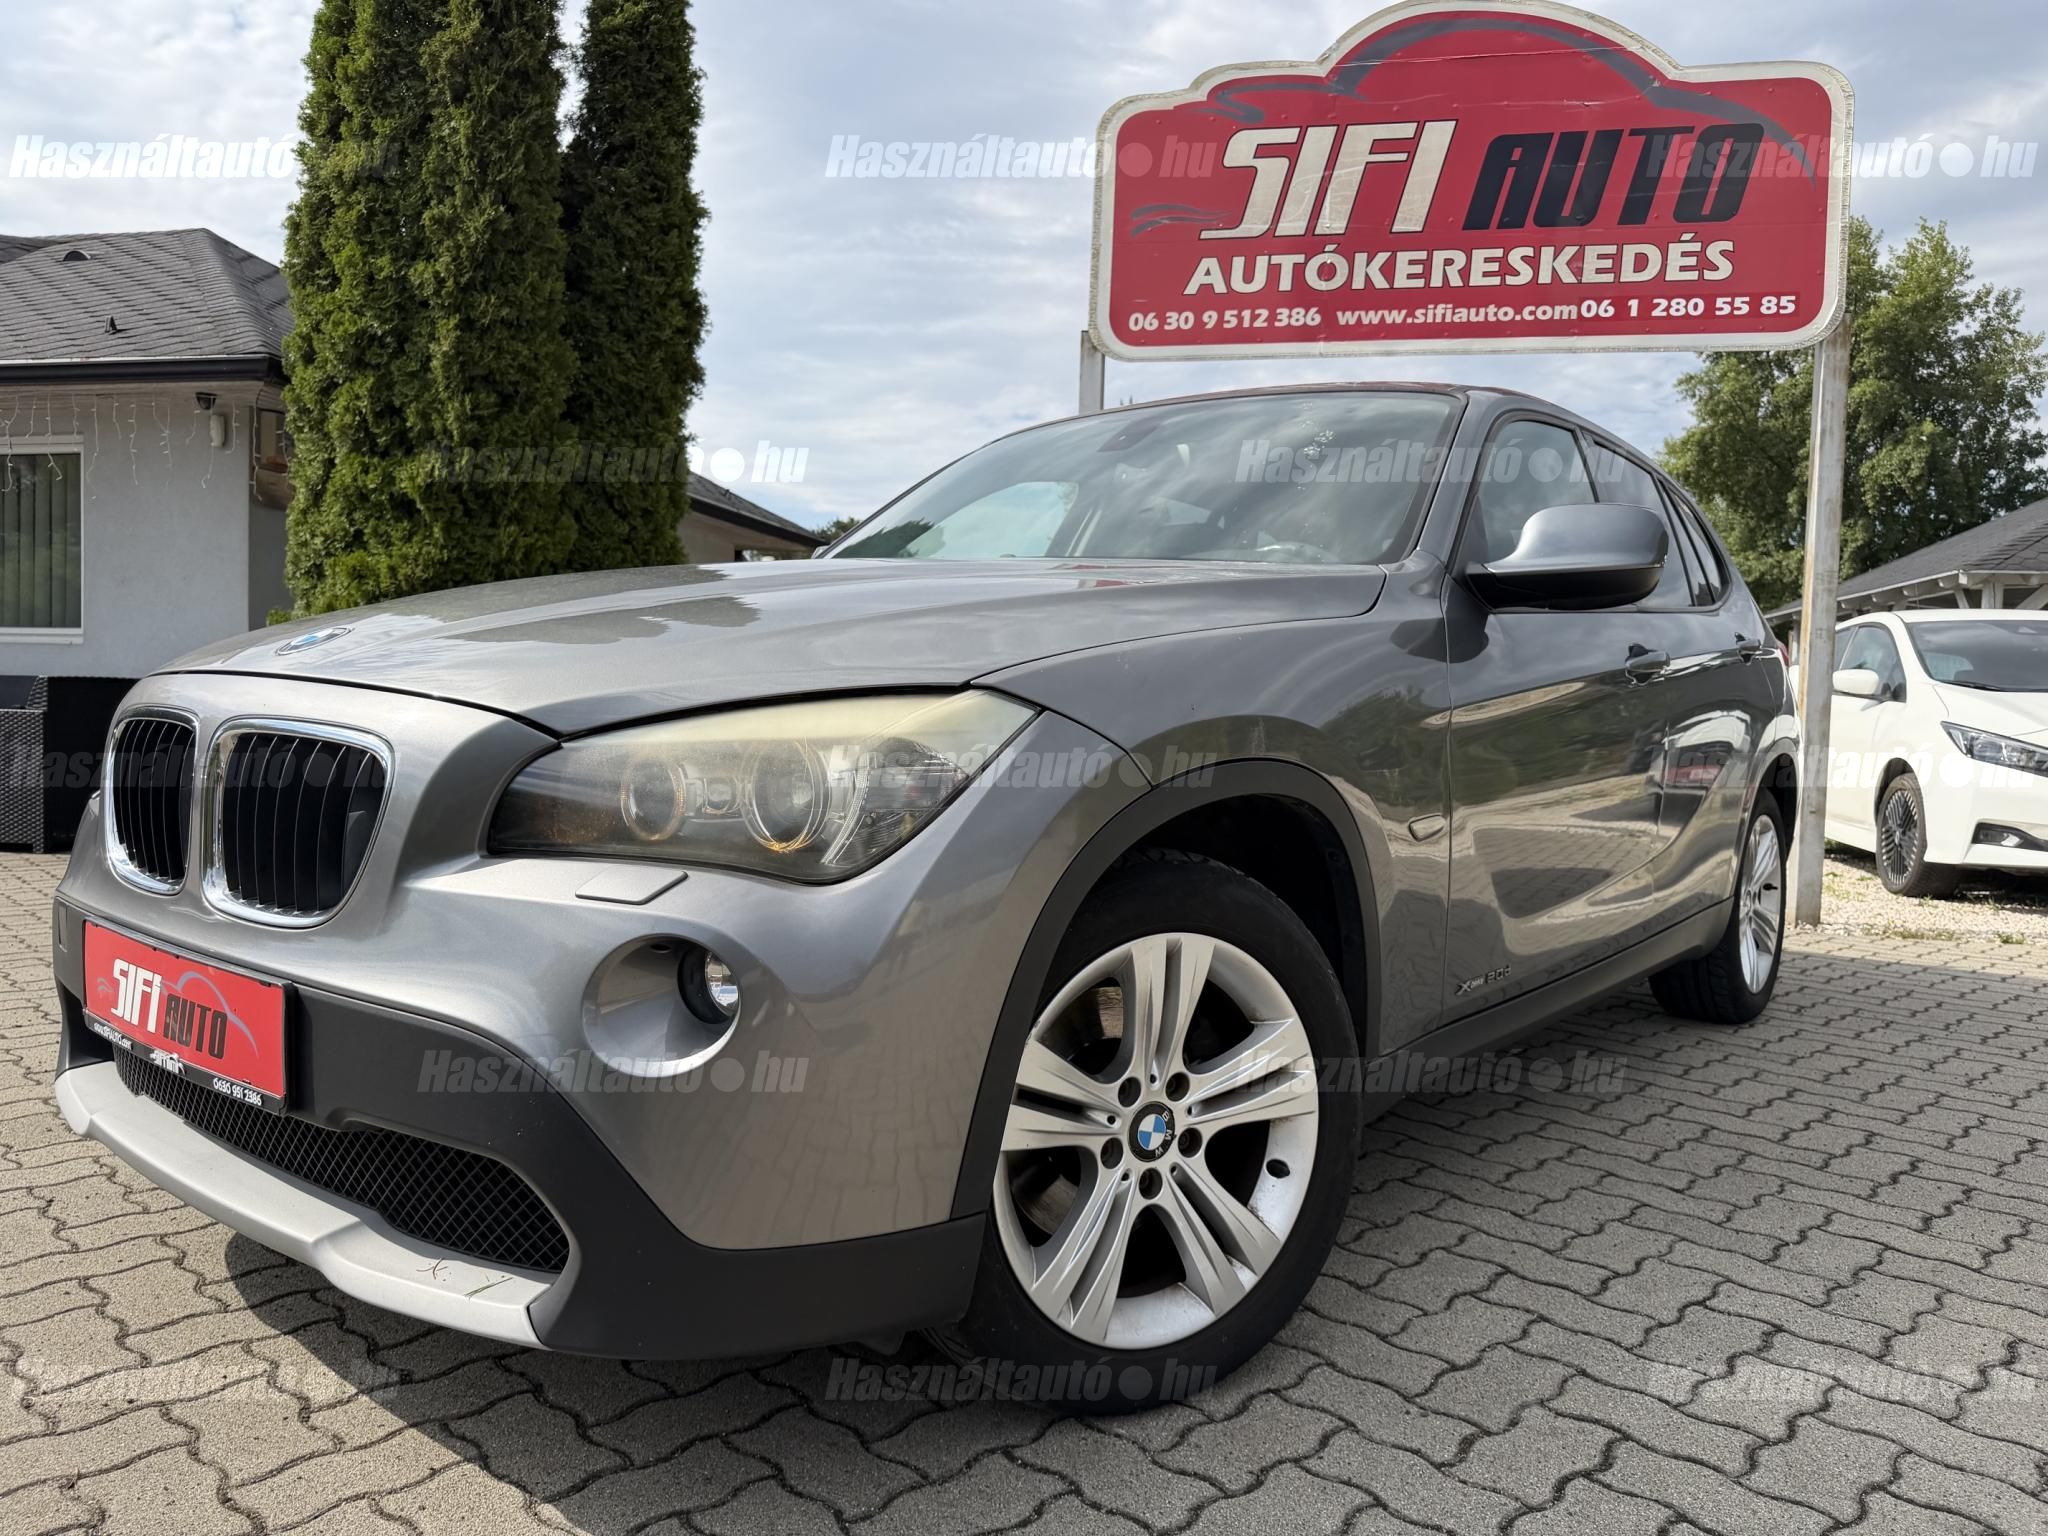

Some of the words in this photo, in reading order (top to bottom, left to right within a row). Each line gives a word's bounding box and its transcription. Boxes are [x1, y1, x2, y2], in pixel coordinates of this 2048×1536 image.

[1198, 119, 1458, 240] SIFI
[1462, 122, 1766, 232] AUTO
[1182, 232, 1735, 297] AUTÓKERESKEDÉS
[1128, 312, 1159, 331] 06
[1164, 311, 1195, 330] 30
[1274, 307, 1322, 327] 386
[1336, 303, 1577, 325] www.sifiauto.com
[1580, 298, 1615, 318] 06
[1628, 299, 1639, 317] 1
[1651, 298, 1705, 317] 280
[1715, 296, 1750, 315] 55
[1760, 295, 1796, 314] 85
[163, 993, 228, 1060] AUTO
